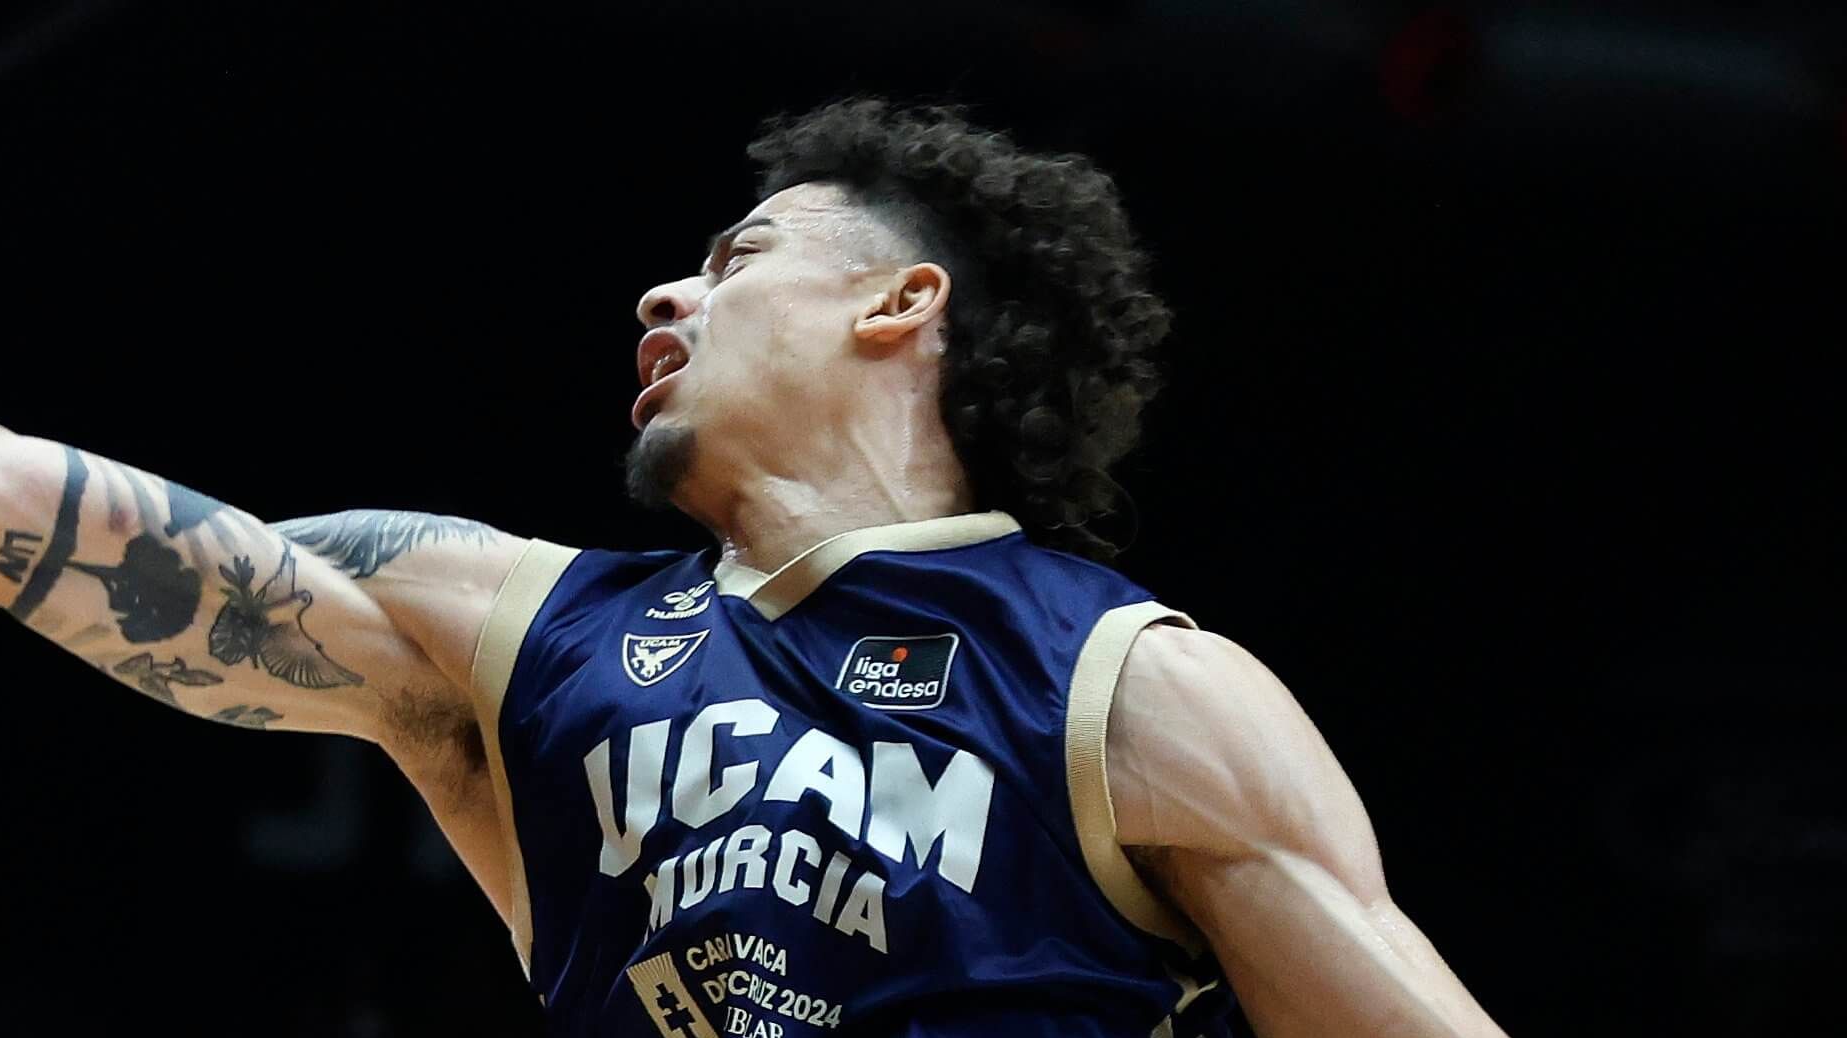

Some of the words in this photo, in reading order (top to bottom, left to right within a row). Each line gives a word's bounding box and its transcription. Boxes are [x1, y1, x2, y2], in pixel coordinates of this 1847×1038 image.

[639, 639, 681, 648] UCAM
[853, 655, 899, 680] liga
[848, 676, 939, 700] endesa
[584, 698, 995, 893] UCAM
[644, 824, 888, 954] MURCIA
[778, 989, 843, 1030] 2024
